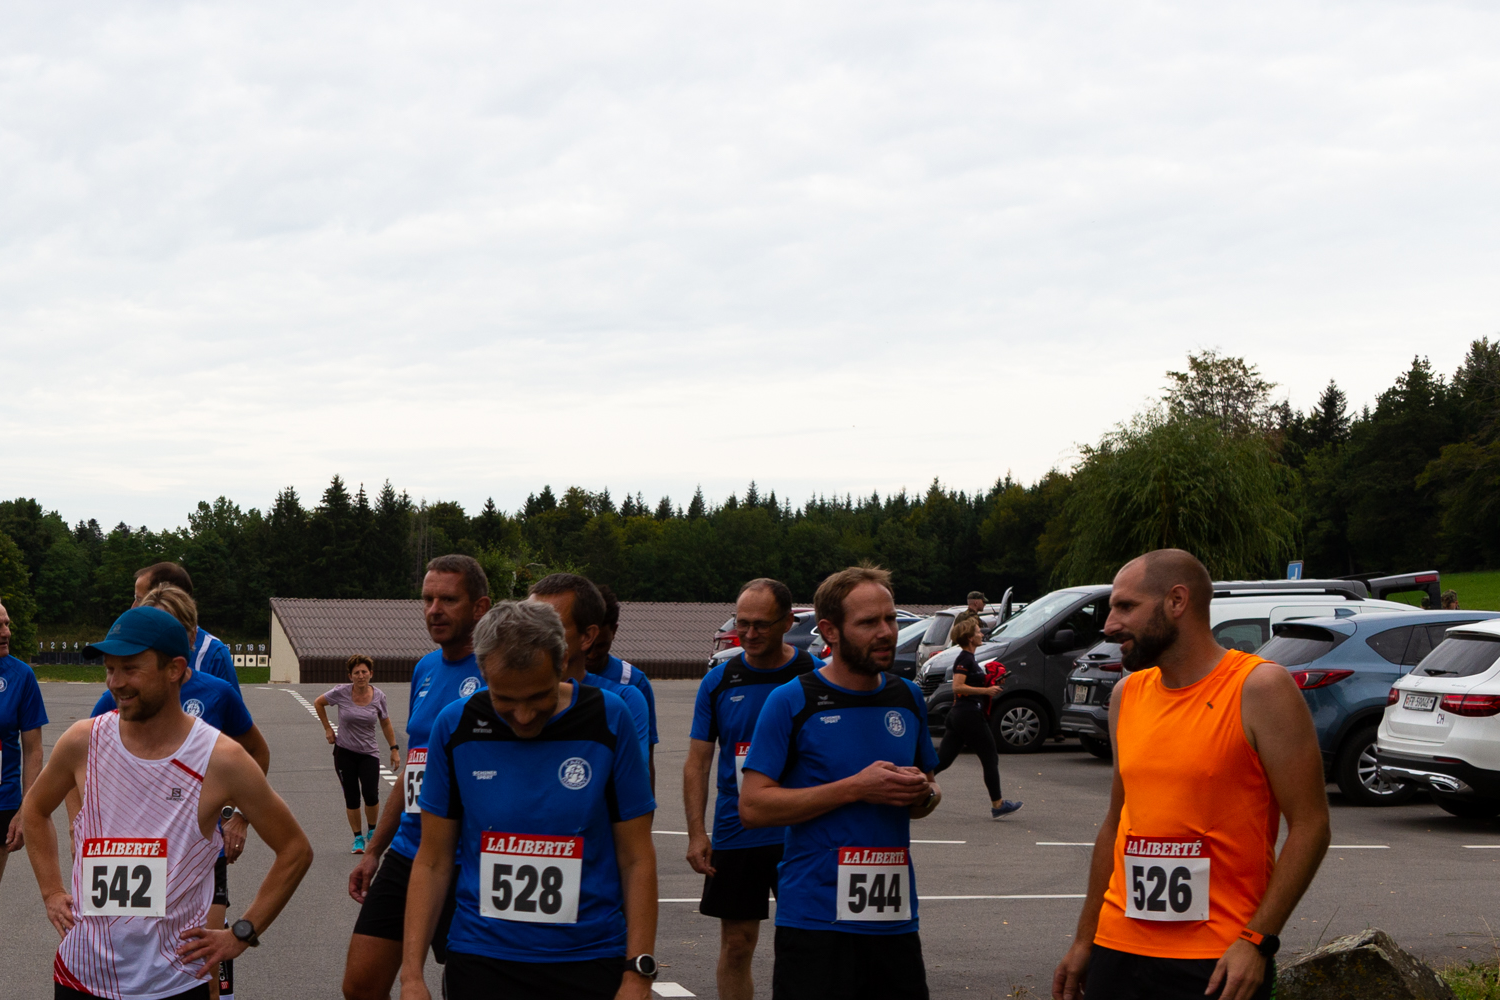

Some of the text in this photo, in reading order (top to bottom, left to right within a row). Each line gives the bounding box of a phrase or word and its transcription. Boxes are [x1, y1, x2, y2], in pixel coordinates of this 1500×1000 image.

[235, 643, 243, 651] 17
[246, 643, 254, 651] 18
[258, 643, 266, 651] 19
[1436, 713, 1446, 725] CH
[407, 770, 425, 807] 53
[86, 840, 161, 856] LA LIBERTÉ
[486, 836, 576, 857] LA LIBERTÉ
[843, 850, 905, 864] LA LIBERTÉ
[1126, 838, 1202, 857] LA LIBERTÉ
[91, 864, 153, 909] 542
[492, 863, 564, 915] 528
[848, 873, 902, 914] 544
[1132, 865, 1193, 913] 526
